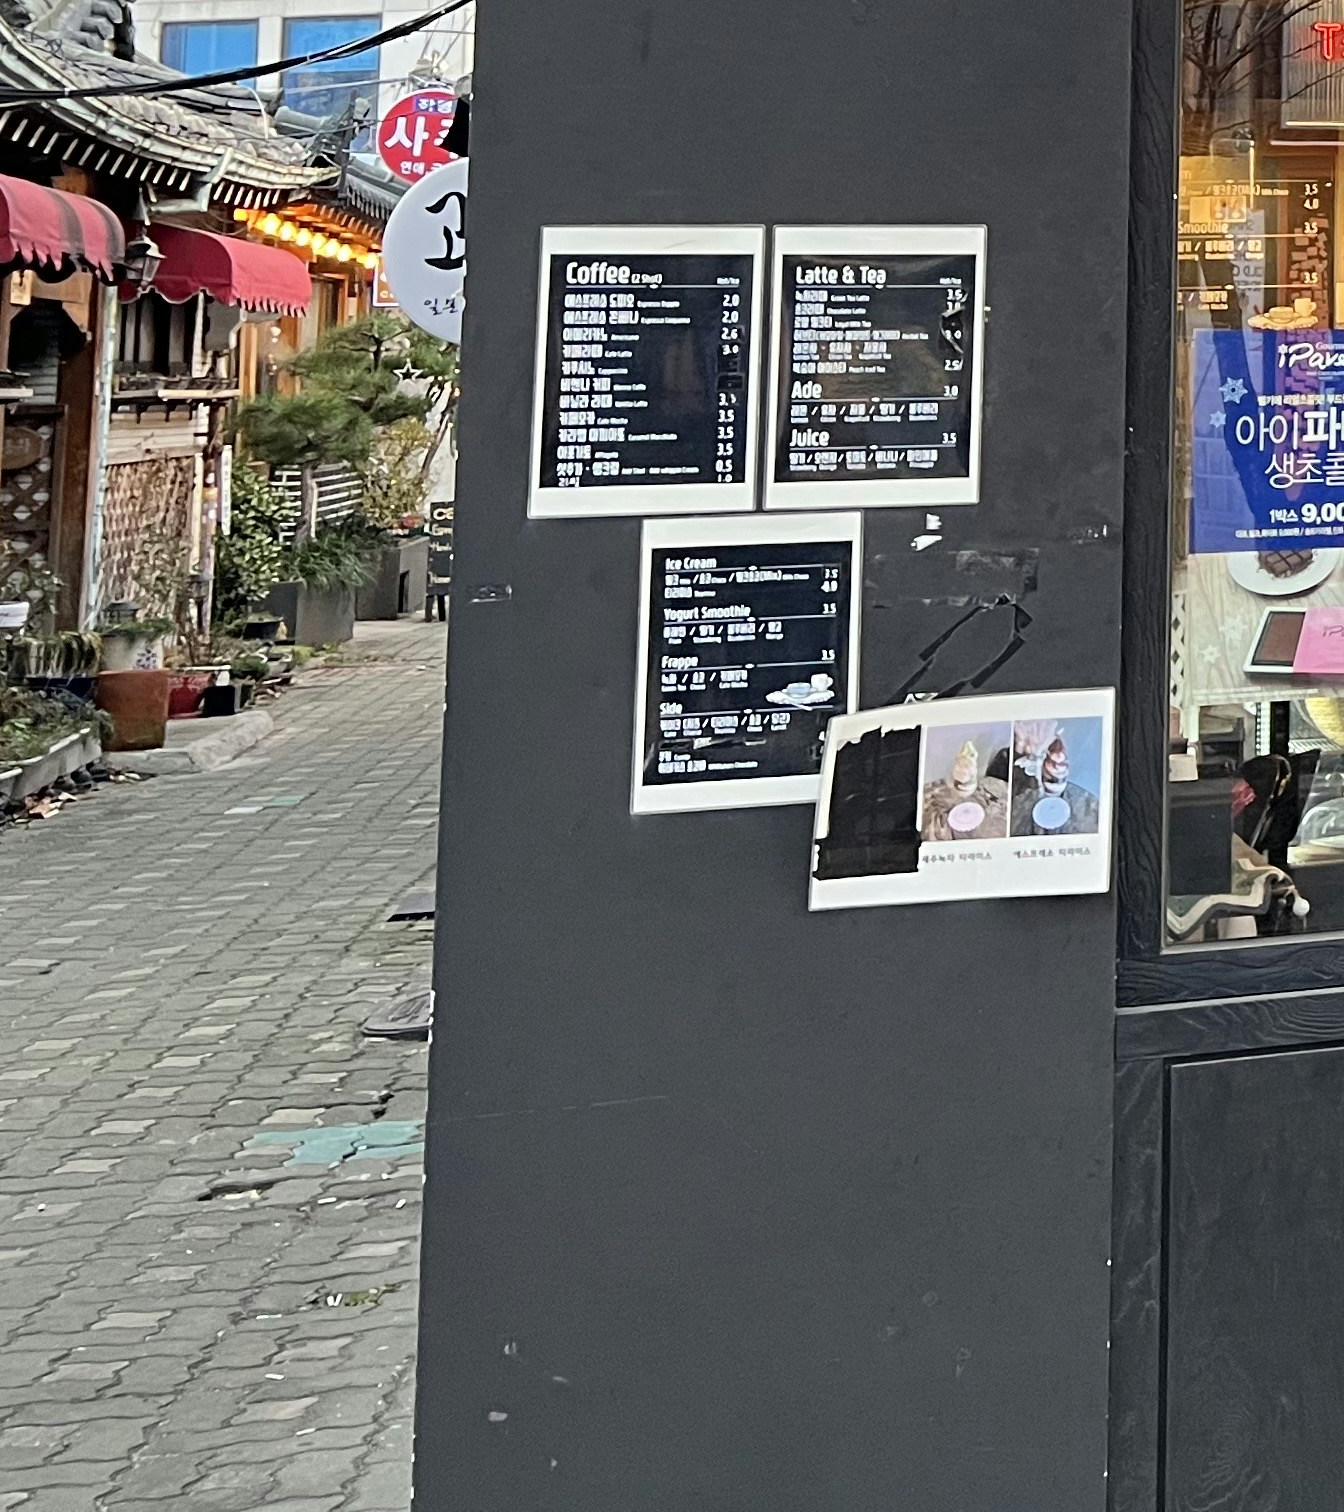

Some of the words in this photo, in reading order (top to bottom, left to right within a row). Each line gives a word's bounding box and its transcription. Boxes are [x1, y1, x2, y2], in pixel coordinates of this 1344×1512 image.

[566, 262, 630, 284] Coffee
[796, 266, 838, 284] Latte
[842, 266, 855, 284] &
[859, 266, 887, 284] Tea
[723, 294, 740, 307] 2.0
[722, 311, 739, 323] 2.0
[791, 381, 822, 399] Ade
[718, 410, 734, 422] 3.5
[717, 426, 734, 439] 3.5
[789, 429, 830, 447] Juice
[942, 433, 957, 444] 3.5
[717, 443, 733, 456] 3.5
[715, 459, 732, 473] 0.5
[1269, 509, 1298, 523] 1박스
[665, 558, 682, 570] Ice
[684, 557, 717, 569] Cream
[664, 607, 699, 622] Yogurt
[701, 604, 751, 619] Smoothie
[662, 655, 698, 670] Frappe
[660, 703, 683, 715] Side
